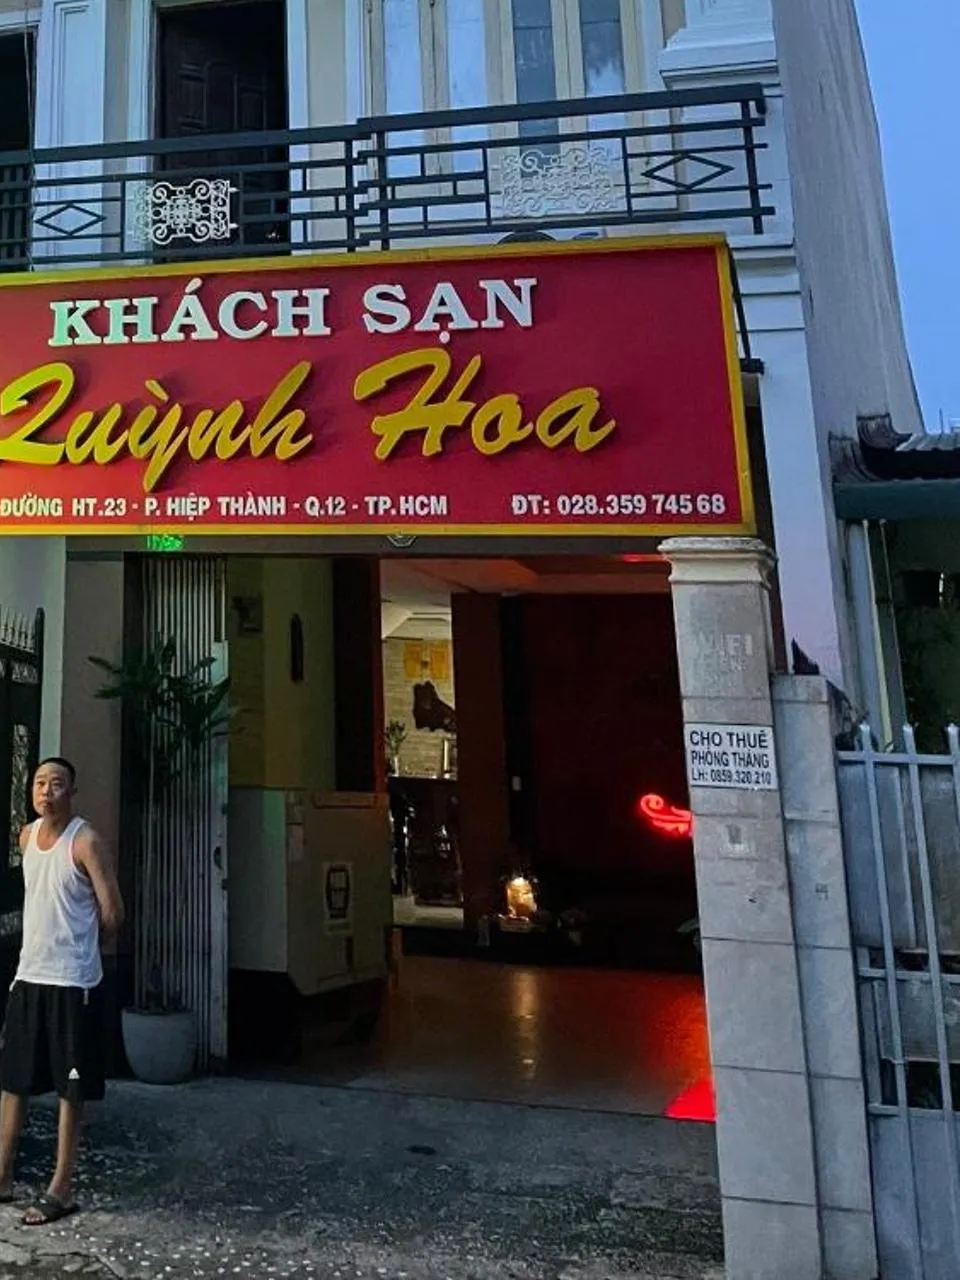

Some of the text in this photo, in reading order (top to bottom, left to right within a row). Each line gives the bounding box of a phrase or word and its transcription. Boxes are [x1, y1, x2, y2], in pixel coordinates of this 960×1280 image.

[48, 277, 538, 346] KHÁCH SẠN
[354, 348, 617, 461] Hoa
[0, 492, 63, 517] ĐƯỜNG
[72, 497, 127, 517] HT.23
[144, 496, 161, 516] P.
[166, 492, 211, 521] HIỆP
[217, 491, 286, 516] THÀNH
[305, 496, 346, 517] Q.12
[364, 496, 448, 516] TP.HCM
[511, 494, 551, 515] ĐT:
[556, 494, 647, 515] 028.359
[690, 729, 768, 748] CHO THUÊ
[691, 747, 729, 767] PHÒNG
